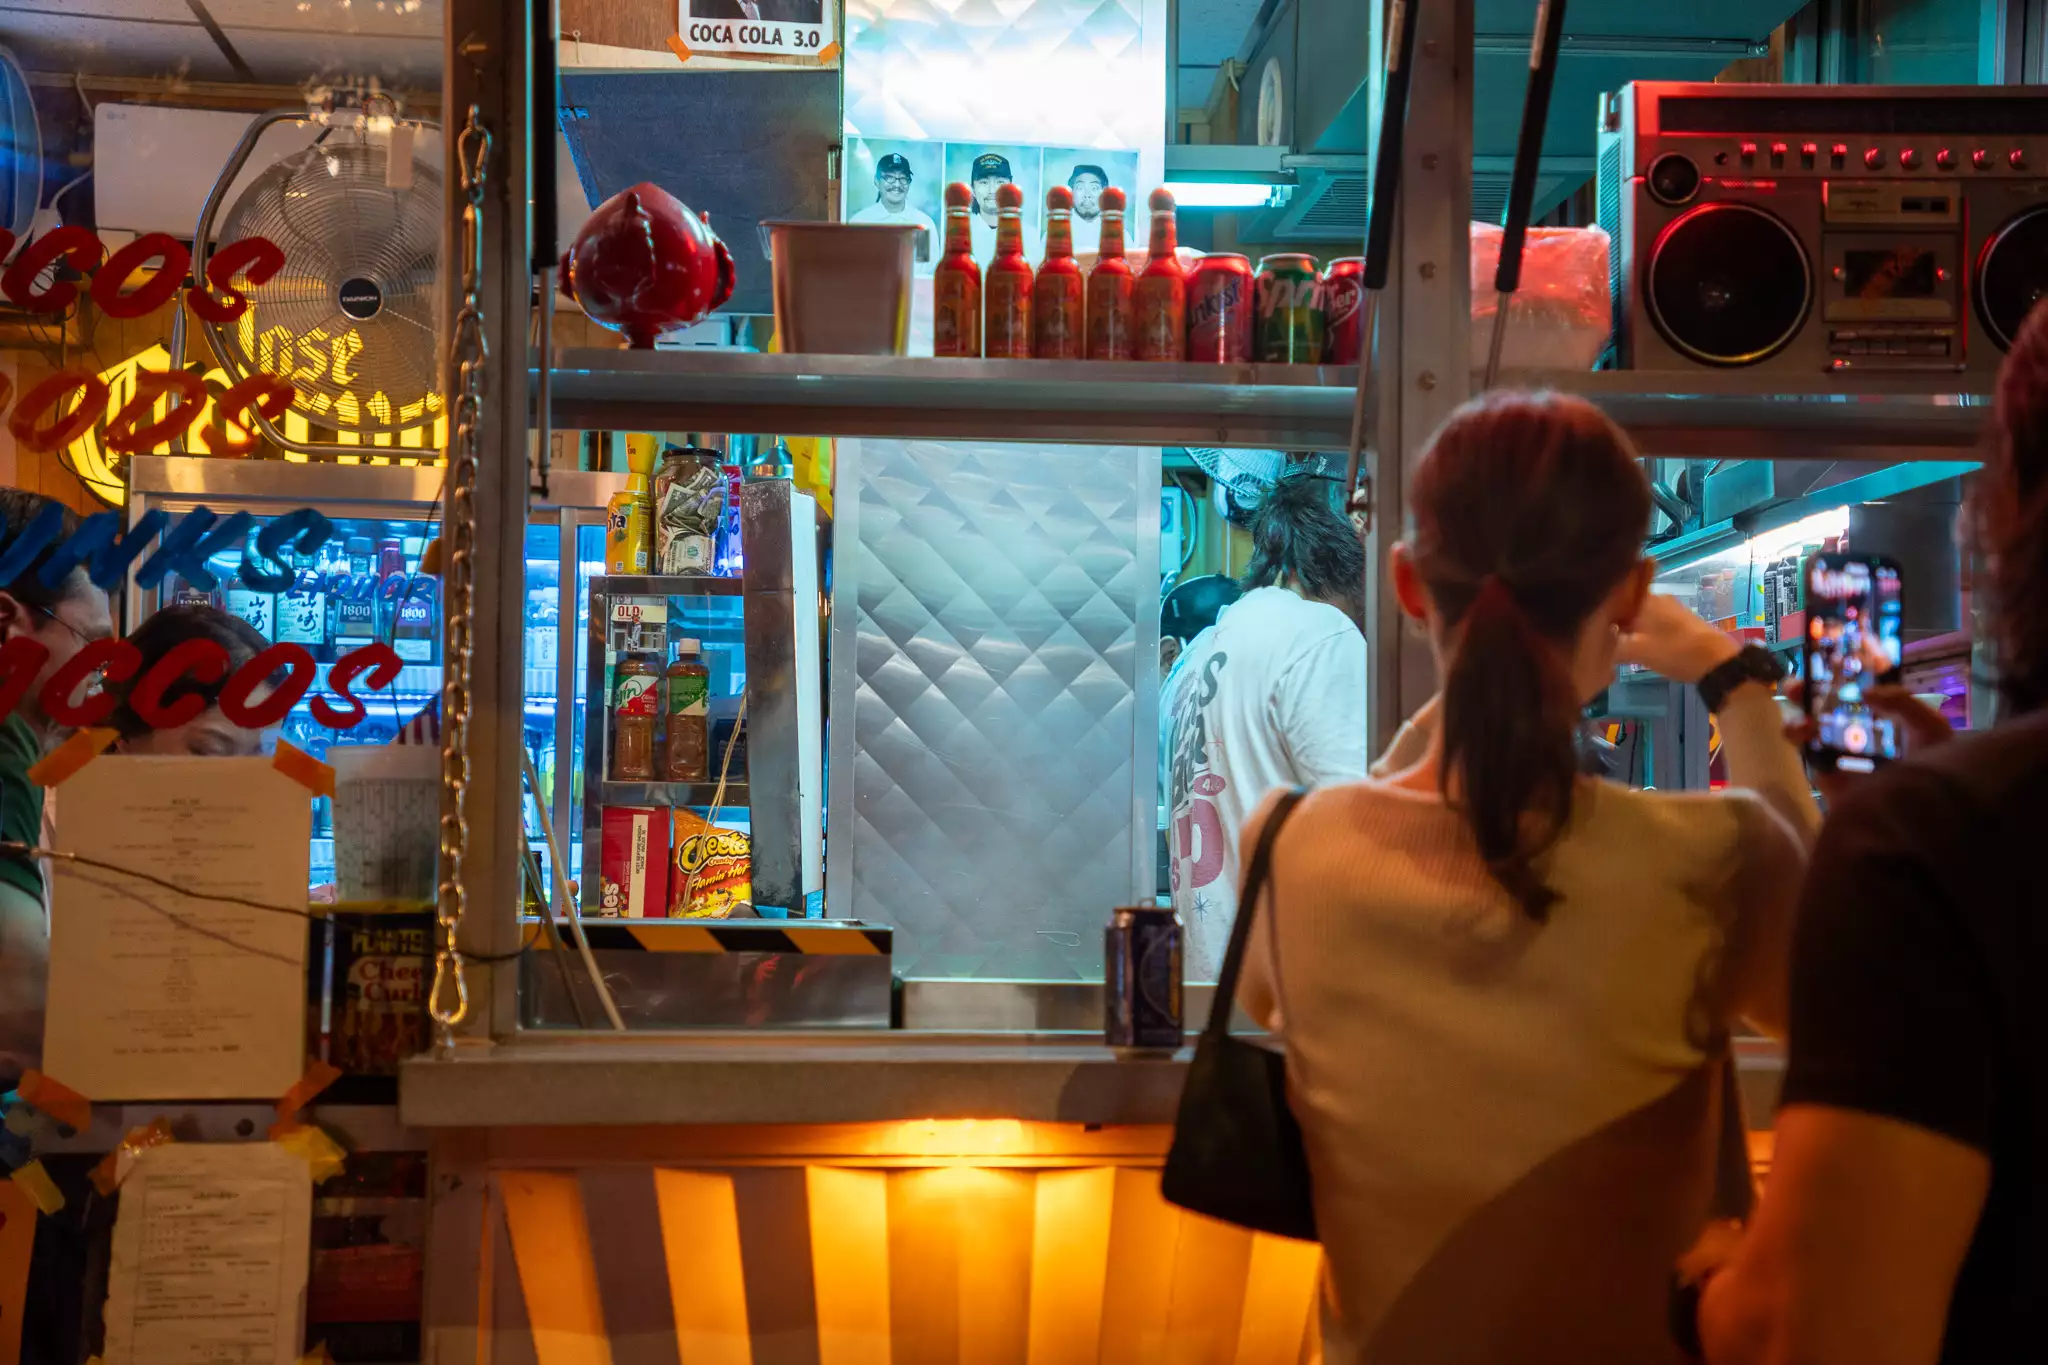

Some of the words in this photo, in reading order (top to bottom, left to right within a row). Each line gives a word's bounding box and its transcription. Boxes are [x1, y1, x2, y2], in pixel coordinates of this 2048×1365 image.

[690, 24, 734, 44] COCA
[739, 26, 783, 46] COLA
[793, 30, 820, 48] 3.0
[342, 603, 371, 616] 1800
[401, 606, 427, 619] 1800
[617, 605, 640, 617] OLD
[728, 863, 752, 878] Hot
